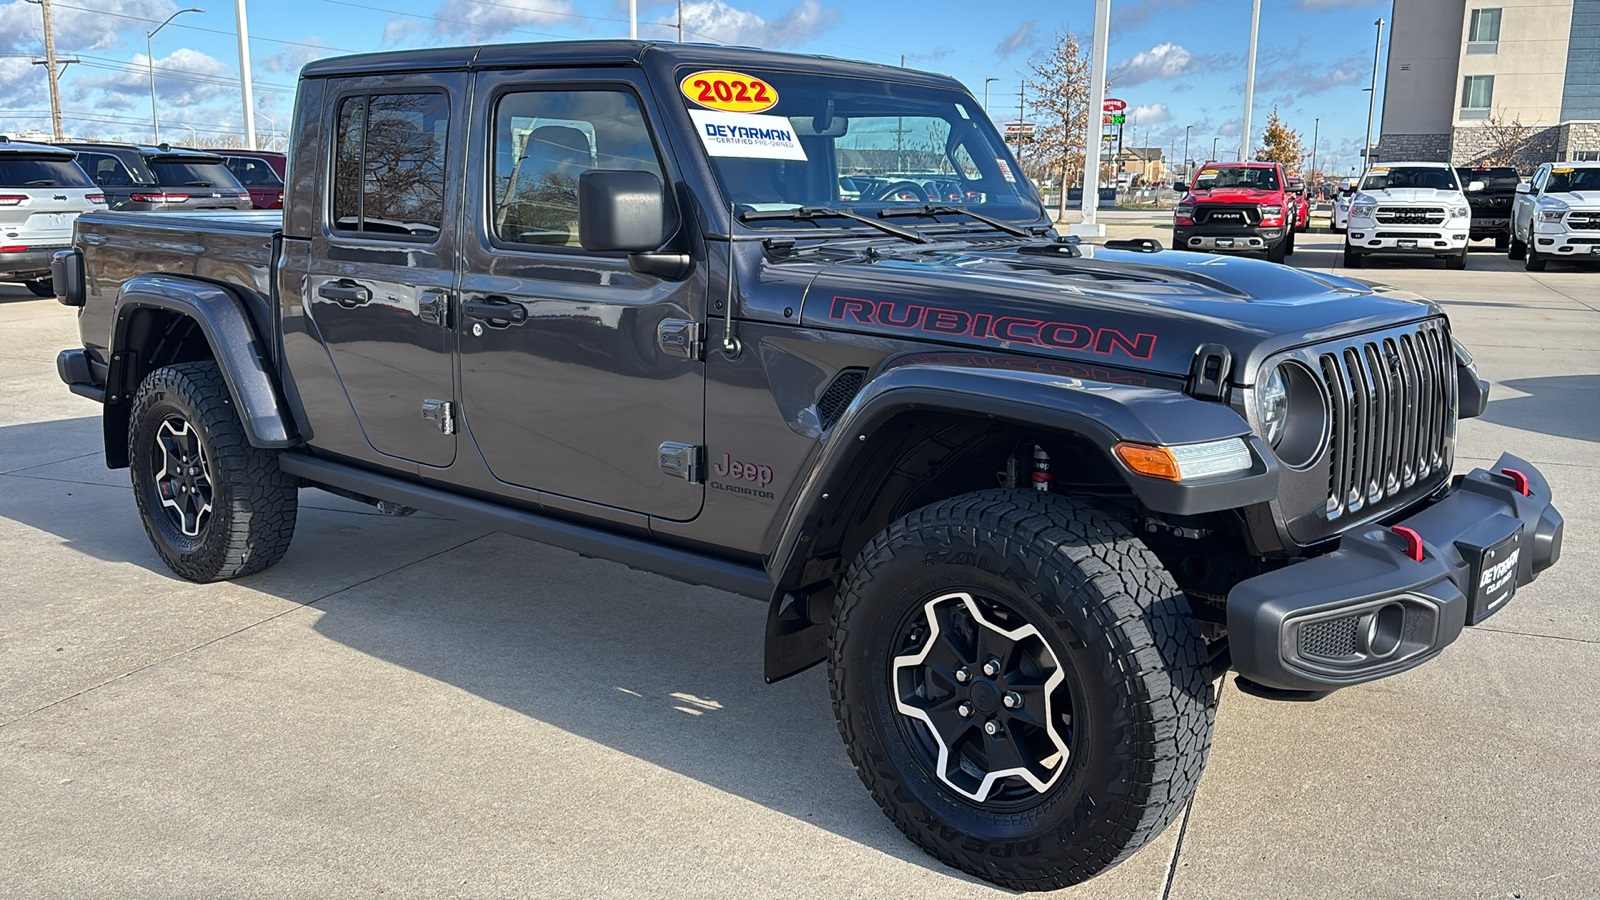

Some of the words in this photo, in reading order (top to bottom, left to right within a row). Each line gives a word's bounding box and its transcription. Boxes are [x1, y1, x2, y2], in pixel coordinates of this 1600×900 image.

[693, 79, 771, 103] 2022
[705, 123, 792, 142] DEYARMAN
[716, 137, 753, 145] CERTIFIED
[754, 139, 794, 149] PRE-OWNED
[828, 295, 1158, 361] RUBICON
[714, 452, 774, 488] Jeep
[710, 481, 775, 500] GLADIATOR
